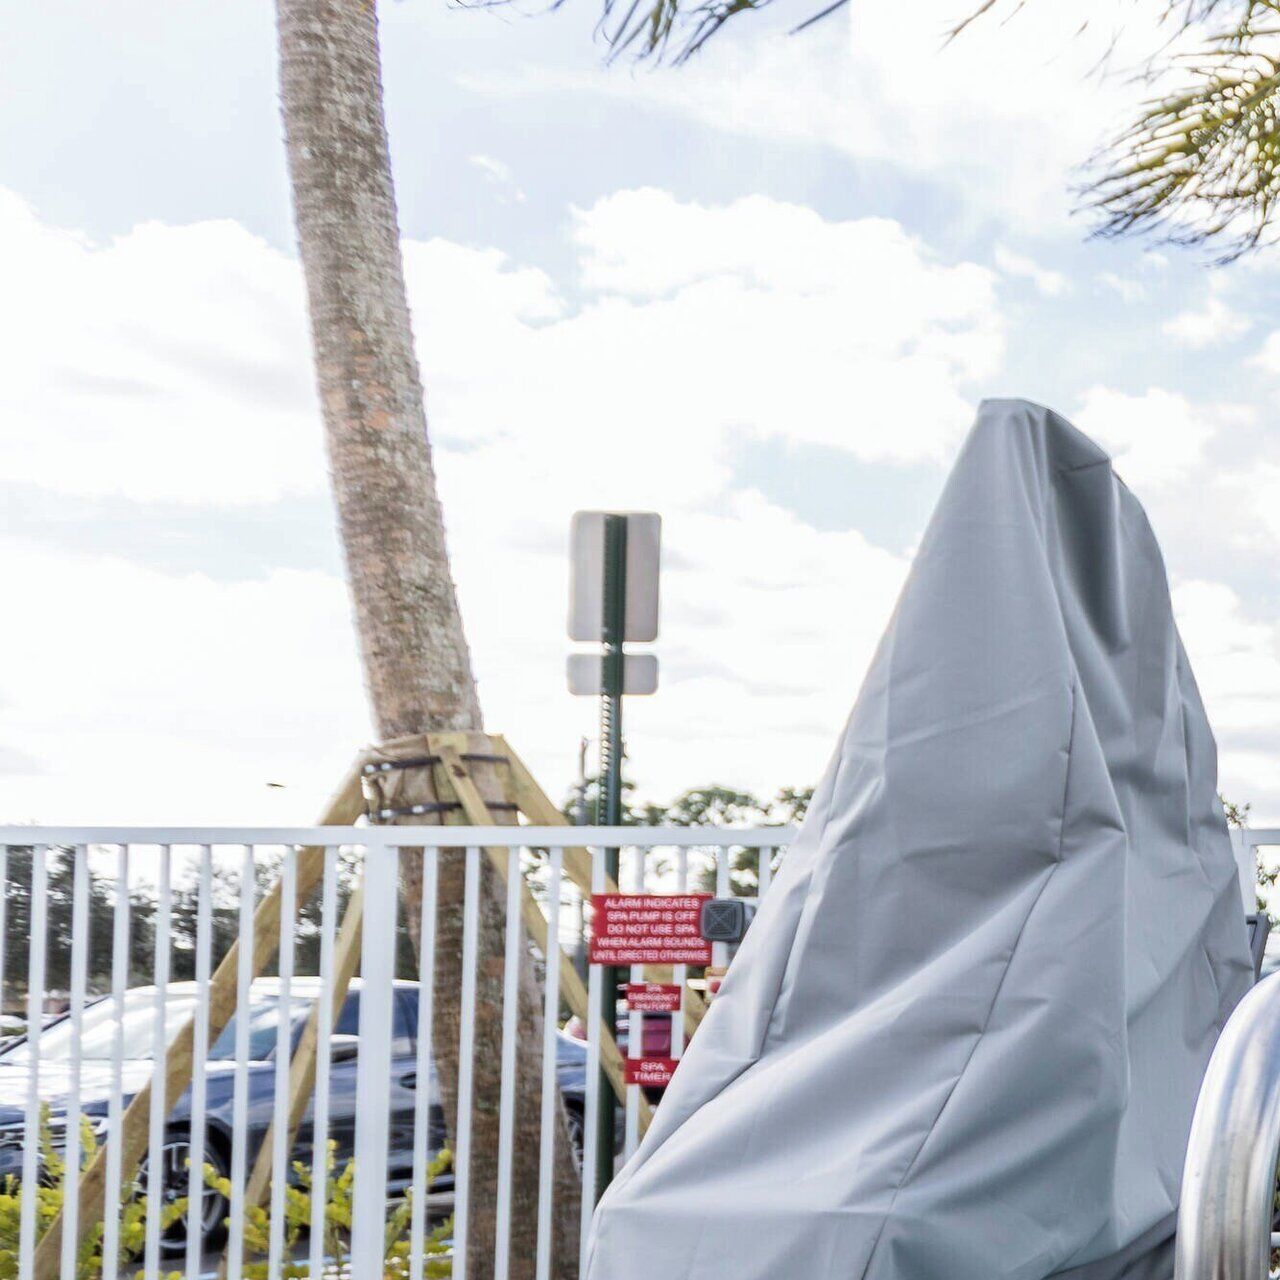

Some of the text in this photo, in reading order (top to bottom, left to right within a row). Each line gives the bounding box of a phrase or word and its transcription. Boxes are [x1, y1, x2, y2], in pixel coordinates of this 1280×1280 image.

[604, 898, 699, 908] ALARM INDICATES
[607, 911, 697, 921] SPA PUMP IS OFF
[607, 924, 695, 934] DO NOT USE SPA
[597, 938, 705, 947] WHEN ALARM SOUNDS
[593, 951, 709, 960] UNTIL DIRECTED OTHERWISE
[640, 1062, 665, 1071] SPA
[634, 1072, 671, 1081] TIMER
